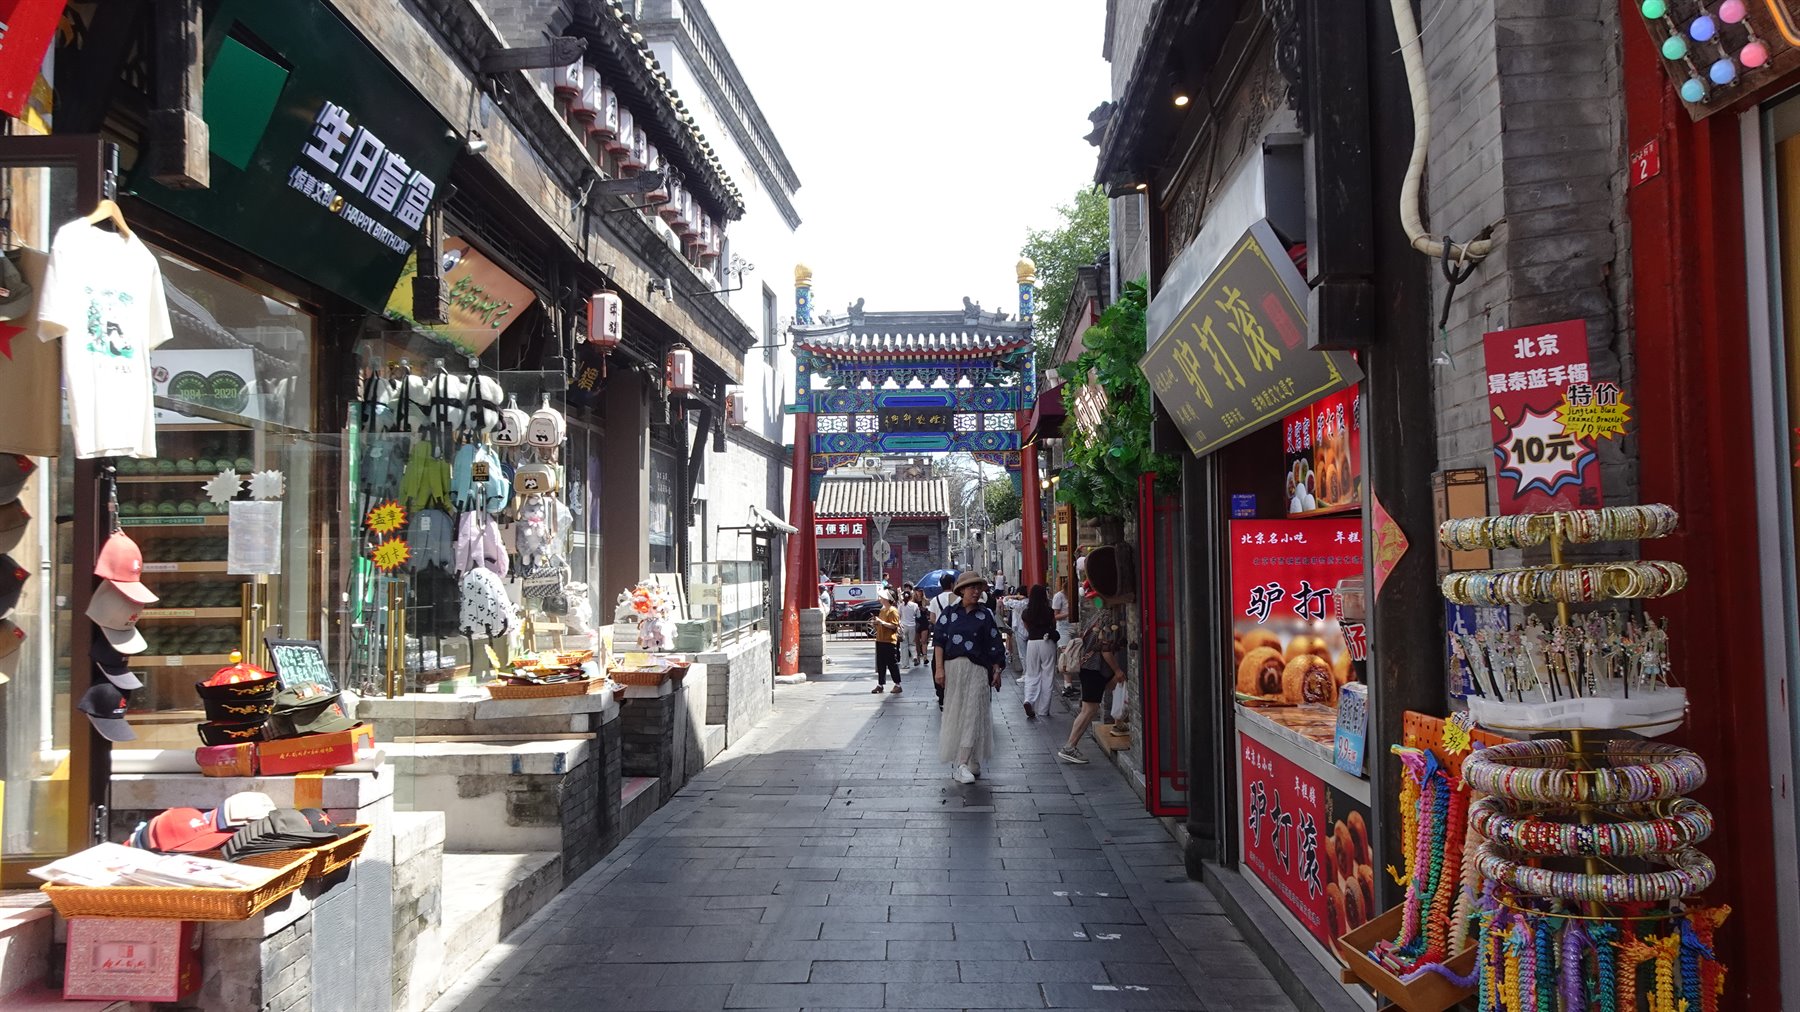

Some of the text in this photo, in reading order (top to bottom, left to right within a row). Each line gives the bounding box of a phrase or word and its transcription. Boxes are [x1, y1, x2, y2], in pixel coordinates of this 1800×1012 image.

[301, 101, 436, 231] 生日盲盒
[1640, 159, 1648, 179] 2
[344, 205, 375, 236] HAPPY
[372, 222, 412, 256] BIRTHDAY
[1172, 285, 1282, 408] 驴打滚
[1514, 334, 1560, 359] 北京
[214, 388, 236, 399] 2020
[1488, 363, 1589, 394] 景泰蓝手镯
[1567, 383, 1619, 406] 特价
[1511, 434, 1576, 464] 10元
[1241, 531, 1363, 544] 北京名小吃 年糕
[1246, 580, 1332, 624] 驴打
[1249, 780, 1323, 900] 驴打滚
